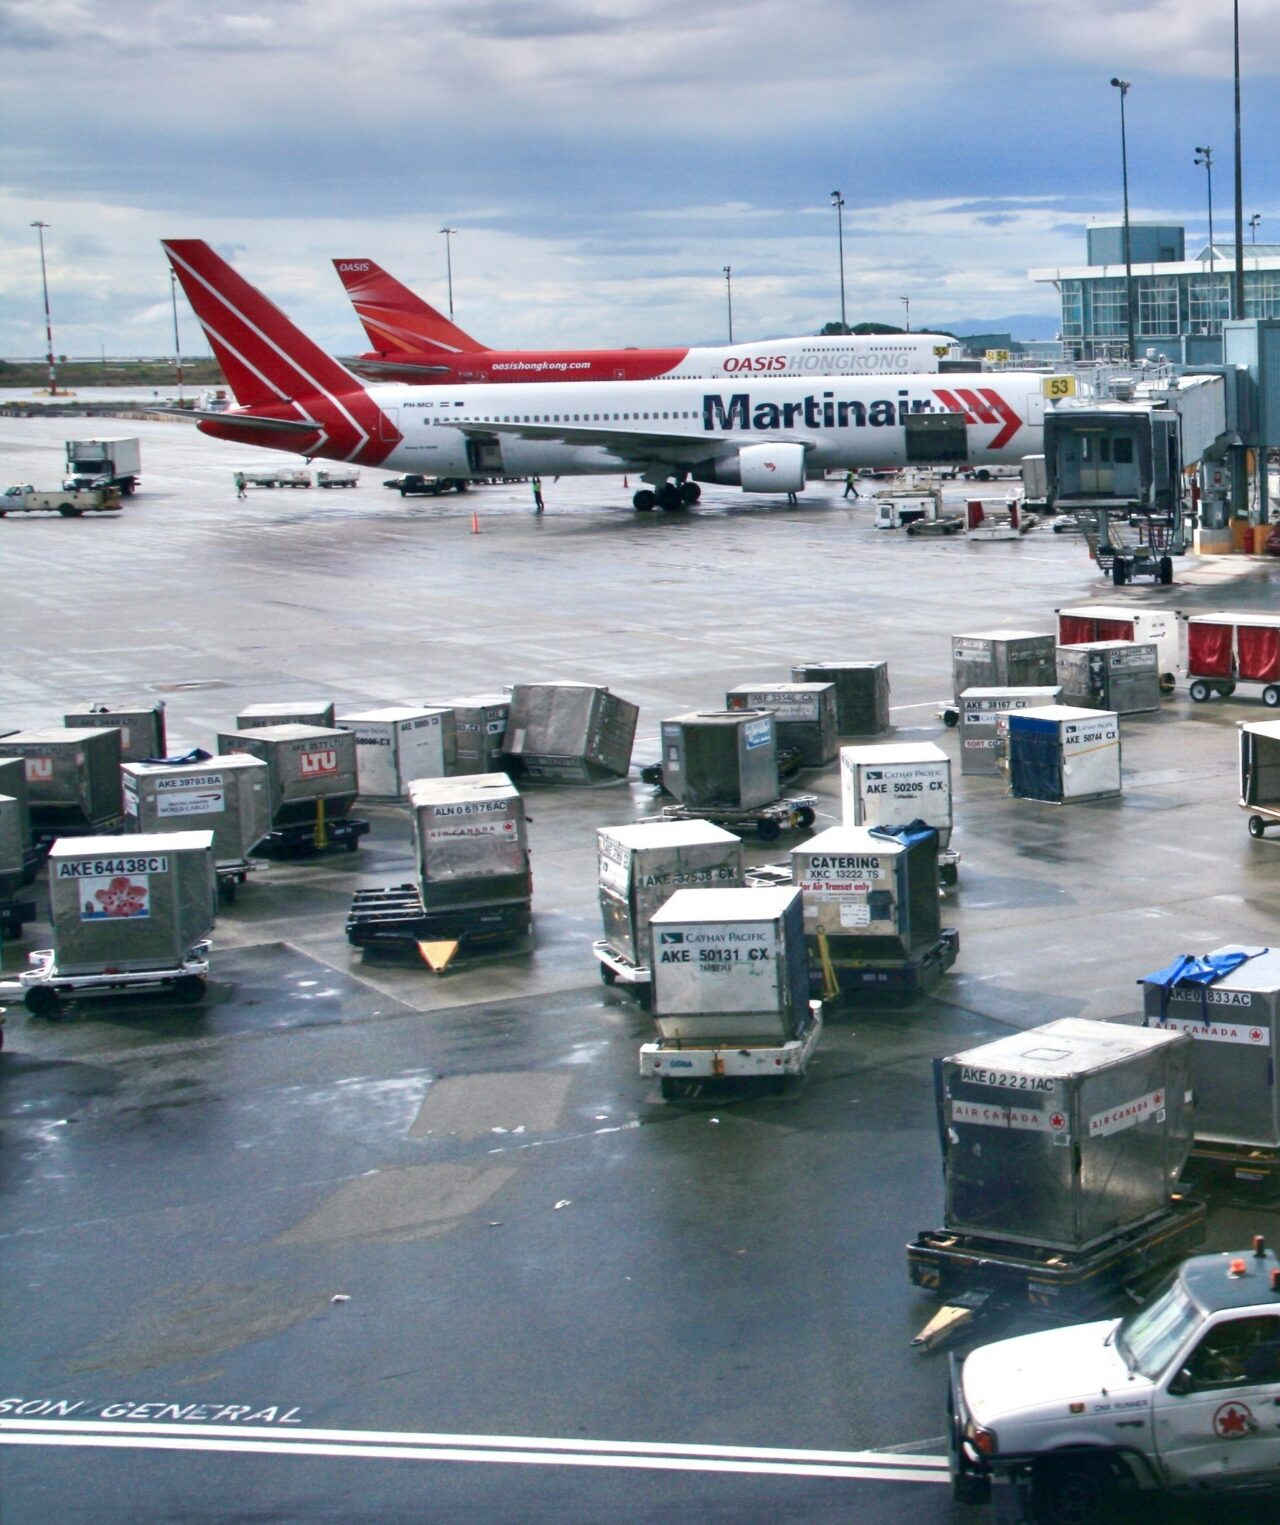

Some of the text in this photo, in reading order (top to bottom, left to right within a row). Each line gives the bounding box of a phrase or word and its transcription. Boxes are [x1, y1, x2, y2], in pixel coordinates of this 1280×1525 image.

[340, 263, 369, 272] OASIS
[491, 361, 591, 372] oasishongkong.com
[1051, 379, 1069, 395] 53
[403, 401, 434, 409] PH-MCI
[703, 390, 932, 431] Martinair
[966, 701, 983, 709] AKE
[1015, 701, 1027, 709] CX
[1066, 735, 1080, 744] AKE
[1106, 731, 1116, 739] CX
[301, 751, 337, 773] LTU
[884, 769, 942, 779] CATHAY PACIFIC
[158, 776, 221, 788] AKE 39793 BA
[866, 781, 943, 793] AKE 50205 CX
[811, 857, 880, 869] CATERING
[811, 869, 880, 879] XKC 13222 TS
[812, 882, 823, 890] Air
[824, 882, 852, 891] Transat
[853, 883, 870, 893] only
[685, 932, 767, 943] CATHAY PACIFIC
[661, 948, 769, 963] AKE 50131 CX
[956, 1106, 1040, 1124] AIR CANADA
[1092, 1100, 1148, 1130] AIR CANADA
[100, 1402, 303, 1423] GENERAL
